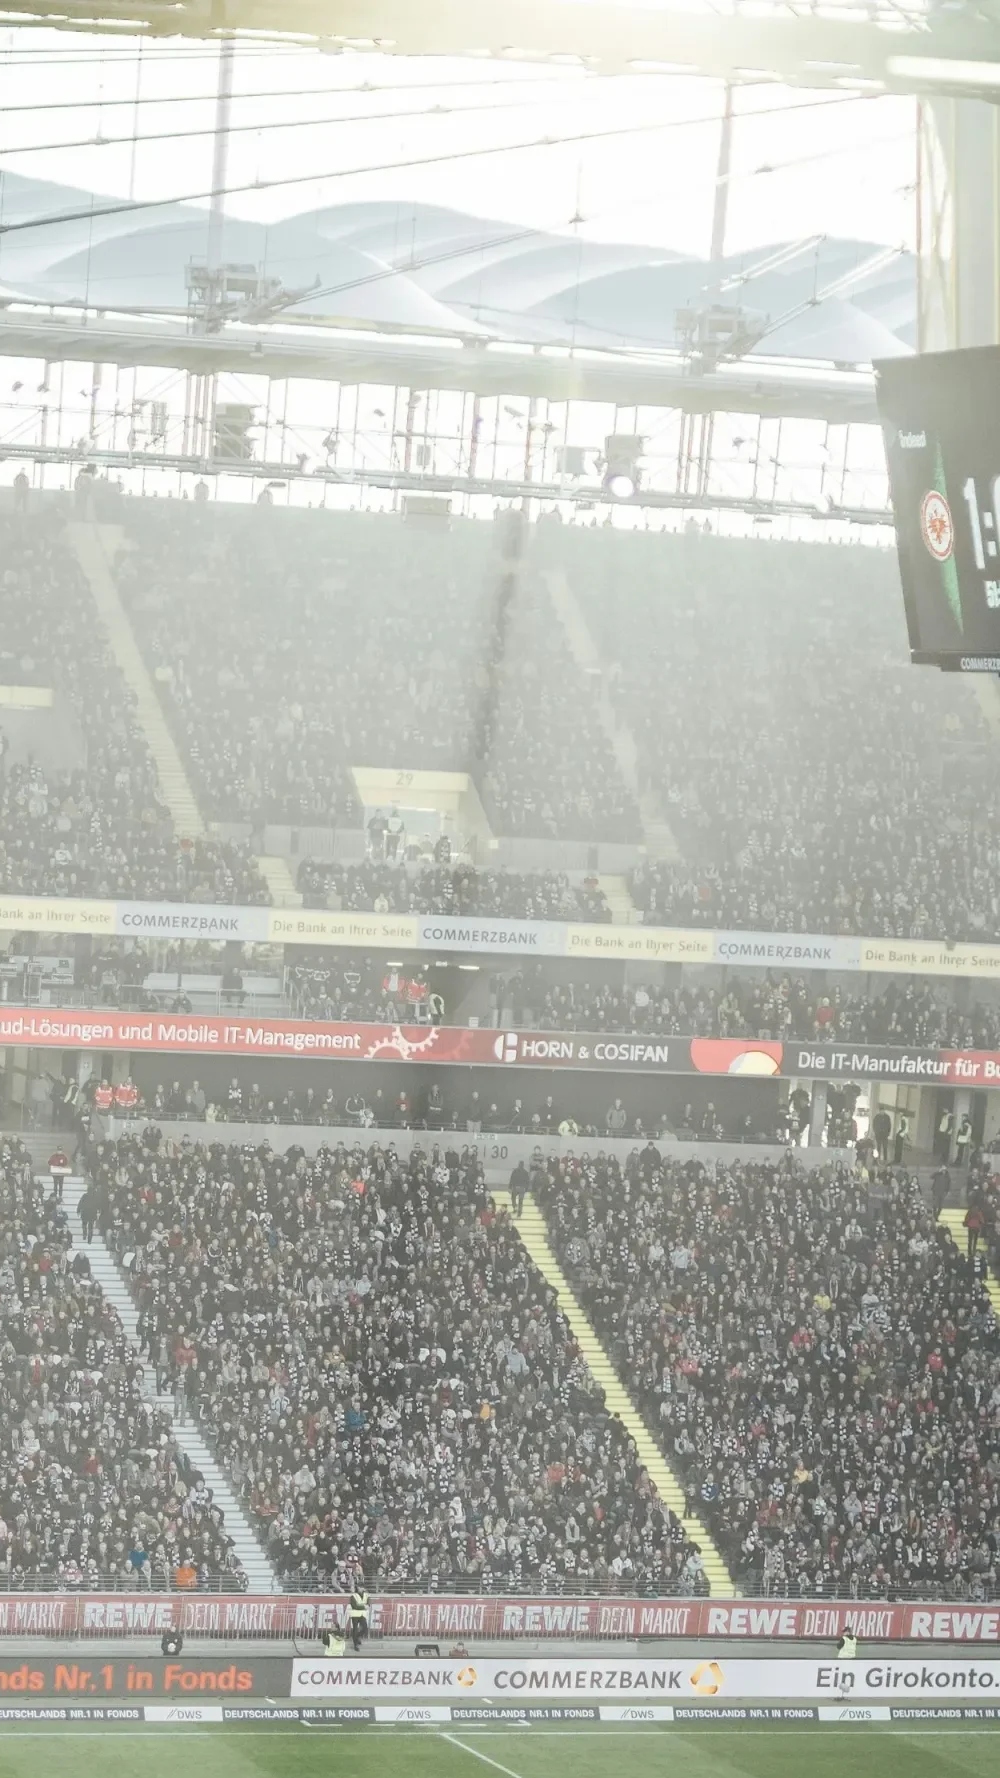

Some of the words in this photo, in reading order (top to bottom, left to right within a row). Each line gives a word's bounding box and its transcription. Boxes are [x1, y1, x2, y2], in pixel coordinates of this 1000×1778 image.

[28, 911, 43, 921] an
[47, 910, 75, 922] Ihrer
[80, 912, 111, 924] Seite
[122, 914, 239, 931] COMMERZBANK
[274, 920, 293, 932] Die
[298, 922, 327, 933] Bank
[331, 926, 345, 935] an
[350, 924, 377, 937] Ihrer
[382, 926, 412, 938] Seite
[423, 928, 538, 945] COMMERZBANK
[571, 935, 590, 947] Die
[595, 936, 624, 948] Bank
[629, 939, 642, 949] an
[646, 940, 675, 952] Ihrer
[678, 941, 708, 953] Seite
[718, 943, 832, 960] COMMERZBANK
[865, 949, 885, 961] Die
[889, 952, 918, 964] Bank
[922, 955, 935, 964] an
[939, 954, 966, 966] Ihrer
[971, 955, 1000, 967] Seite
[119, 1024, 152, 1040] und
[158, 1025, 219, 1043] Mobile
[224, 1027, 361, 1051] IT-Management
[522, 1041, 573, 1058] HORN
[578, 1045, 589, 1059] &
[594, 1043, 668, 1063] COSIFAN
[799, 1052, 826, 1070] Die
[831, 1053, 951, 1076] IT-Manufaktur
[955, 1058, 980, 1077] für
[491, 1145, 508, 1160] 30
[15, 1602, 67, 1629] MARKT
[83, 1603, 173, 1629] REWE
[186, 1602, 220, 1629] DEIN
[225, 1603, 276, 1630] MARKT
[395, 1604, 431, 1630] DEIN
[437, 1603, 488, 1631] MARKT
[503, 1605, 590, 1631] REWE
[601, 1606, 634, 1633] DEIN
[640, 1606, 692, 1635] MARKT
[707, 1608, 798, 1635] REWE
[804, 1610, 840, 1636] DEIN
[845, 1610, 894, 1637] MARKT
[910, 1611, 999, 1639] REWE
[126, 1665, 152, 1690] in
[164, 1664, 253, 1691] Fonds
[298, 1670, 454, 1686] COMMERZBANK
[493, 1670, 683, 1689] COMMERZBANK
[816, 1667, 855, 1688] Ein
[865, 1667, 1000, 1688] Girokonto.
[70, 1709, 92, 1719] NR.1
[94, 1709, 103, 1719] IN
[107, 1709, 139, 1719] FONDS
[177, 1711, 202, 1720] DWS
[225, 1709, 299, 1719] DEUTSCHLANDS
[303, 1709, 323, 1719] NR.1
[326, 1709, 336, 1719] IN
[338, 1709, 370, 1719] FONDS
[406, 1710, 431, 1719] DWS
[453, 1709, 526, 1719] DEUTSCHLANDS
[529, 1709, 549, 1719] NR.1
[551, 1709, 561, 1719] IN
[564, 1709, 595, 1719] FONDS
[631, 1710, 654, 1719] DWS
[675, 1709, 746, 1719] DEUTSCHLANDS
[750, 1709, 769, 1719] NR.1
[771, 1709, 781, 1719] IN
[784, 1709, 814, 1719] FONDS
[849, 1710, 872, 1719] DWS
[892, 1709, 961, 1718] DEUTSCHLANDS
[964, 1709, 982, 1718] NR.1
[985, 1709, 995, 1718] IN
